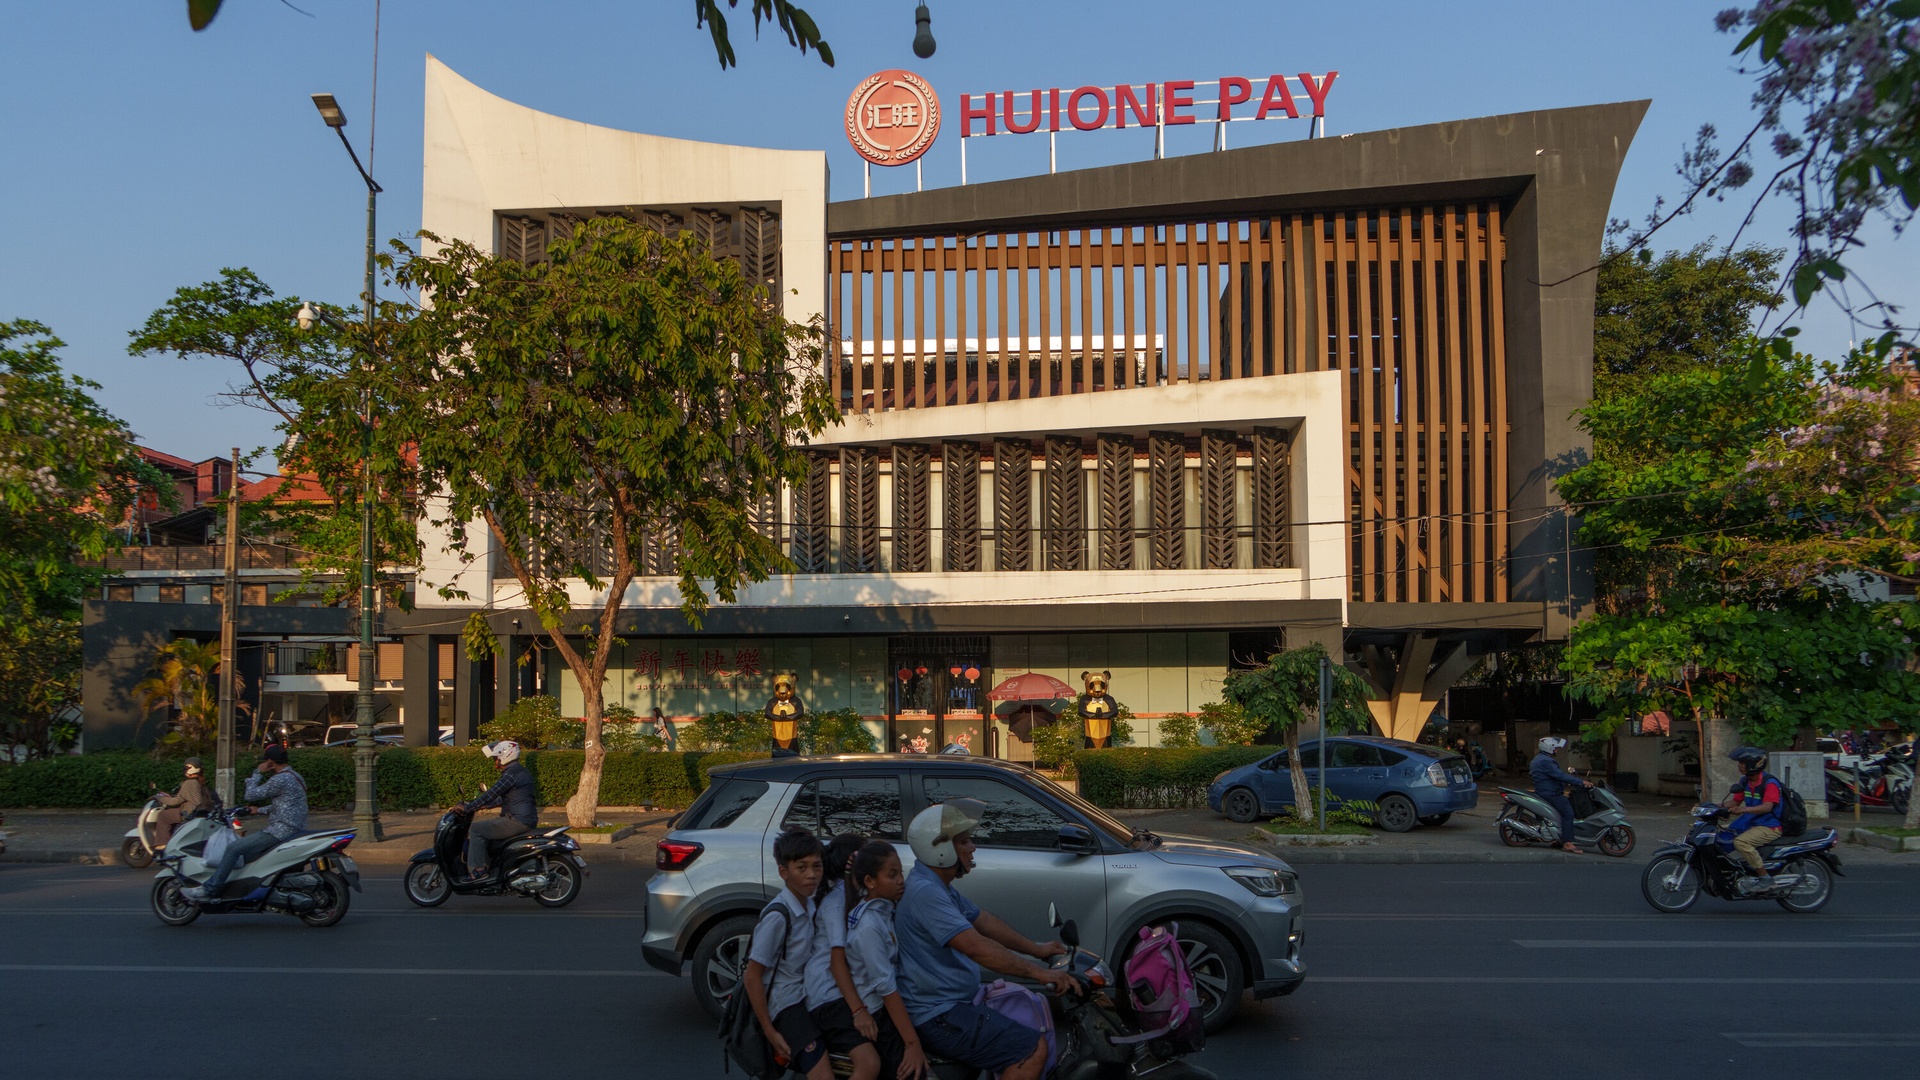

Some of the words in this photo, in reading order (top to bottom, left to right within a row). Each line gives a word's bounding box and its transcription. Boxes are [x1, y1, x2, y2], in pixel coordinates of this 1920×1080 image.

[866, 102, 918, 130] 汇旺
[960, 80, 1196, 138] HUIONE
[1218, 71, 1339, 121] PAY
[634, 649, 762, 680] 新年快樂
